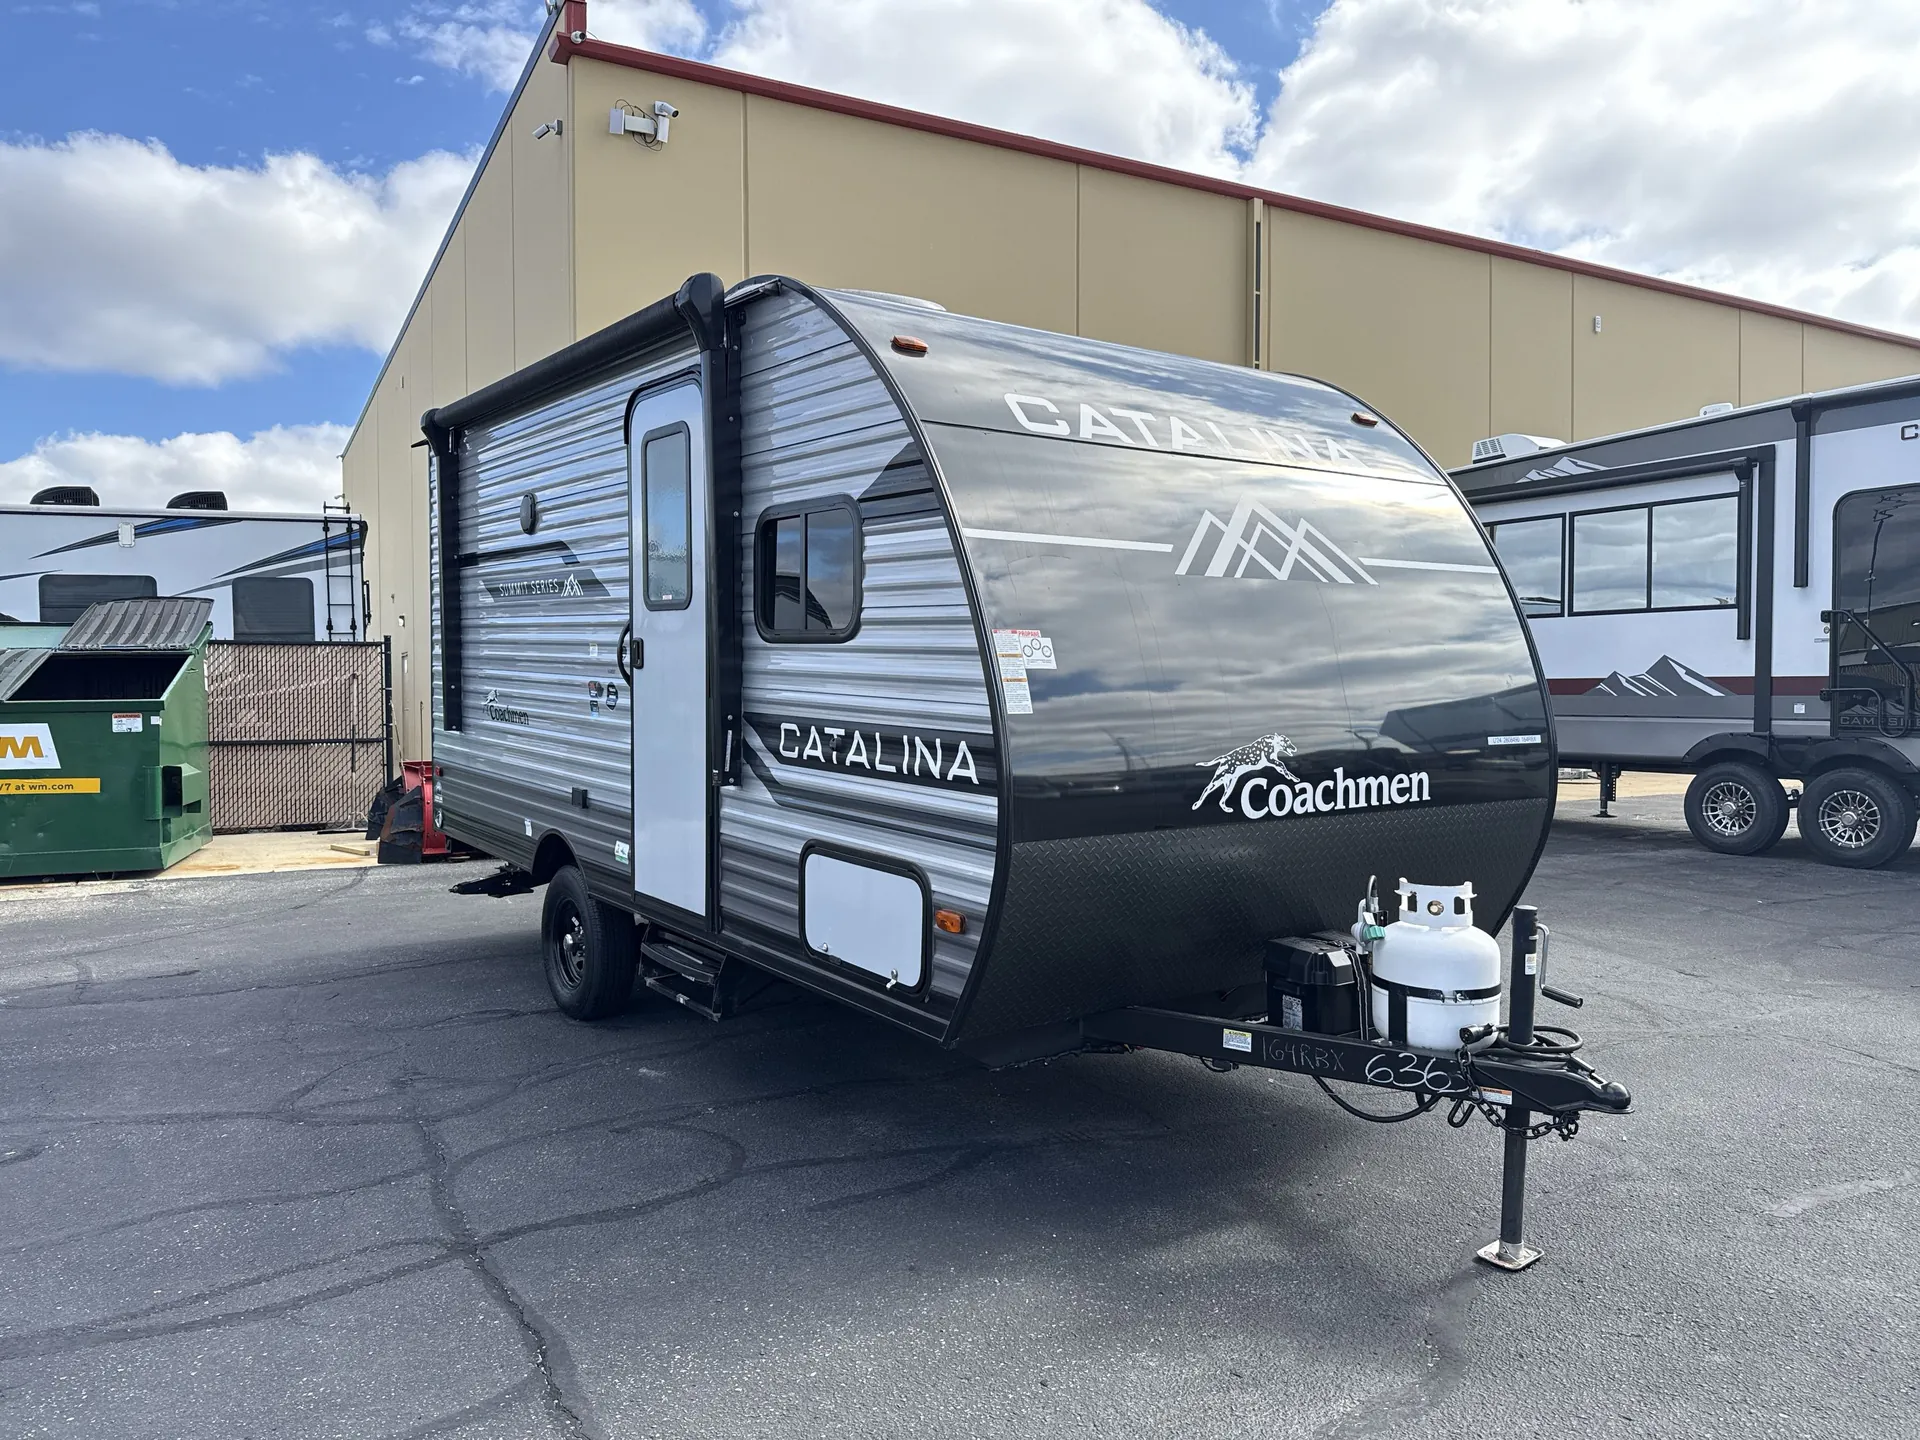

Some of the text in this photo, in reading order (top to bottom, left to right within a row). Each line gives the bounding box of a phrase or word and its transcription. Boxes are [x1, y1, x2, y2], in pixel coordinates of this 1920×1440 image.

[1004, 393, 1369, 469] CATALINA
[499, 578, 559, 597] SUMMIT SERIES
[489, 705, 529, 725] Coachmen
[779, 722, 979, 785] CATALINA
[15, 783, 25, 791] at
[28, 783, 74, 791] wm.com
[1240, 767, 1431, 820] Coachmen
